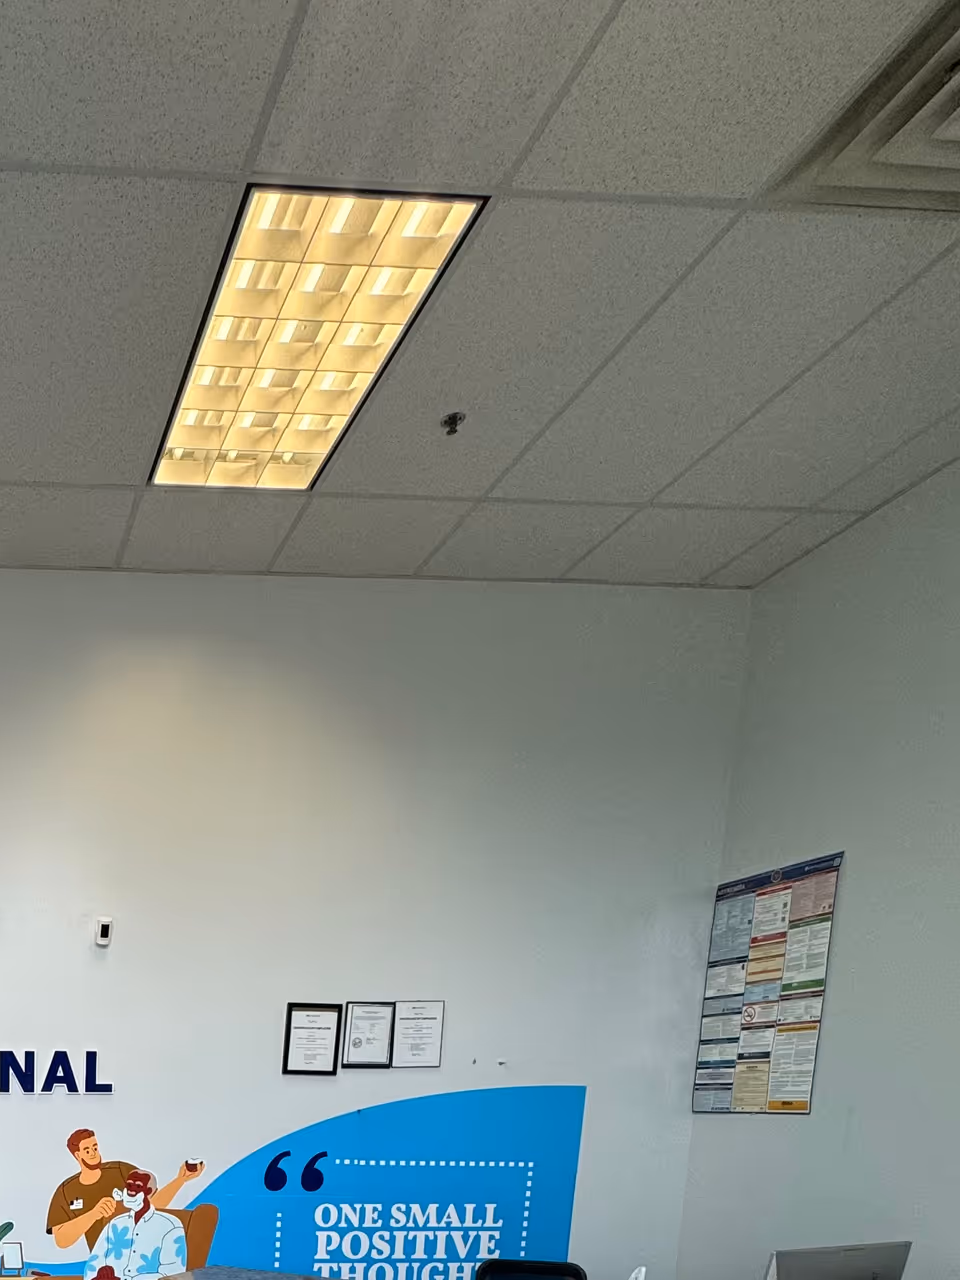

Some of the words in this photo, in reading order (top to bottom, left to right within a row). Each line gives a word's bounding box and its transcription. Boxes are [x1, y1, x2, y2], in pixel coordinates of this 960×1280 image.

[314, 1203, 383, 1228] ONE
[390, 1203, 504, 1228] SMALL
[314, 1230, 501, 1259] POSITIVE
